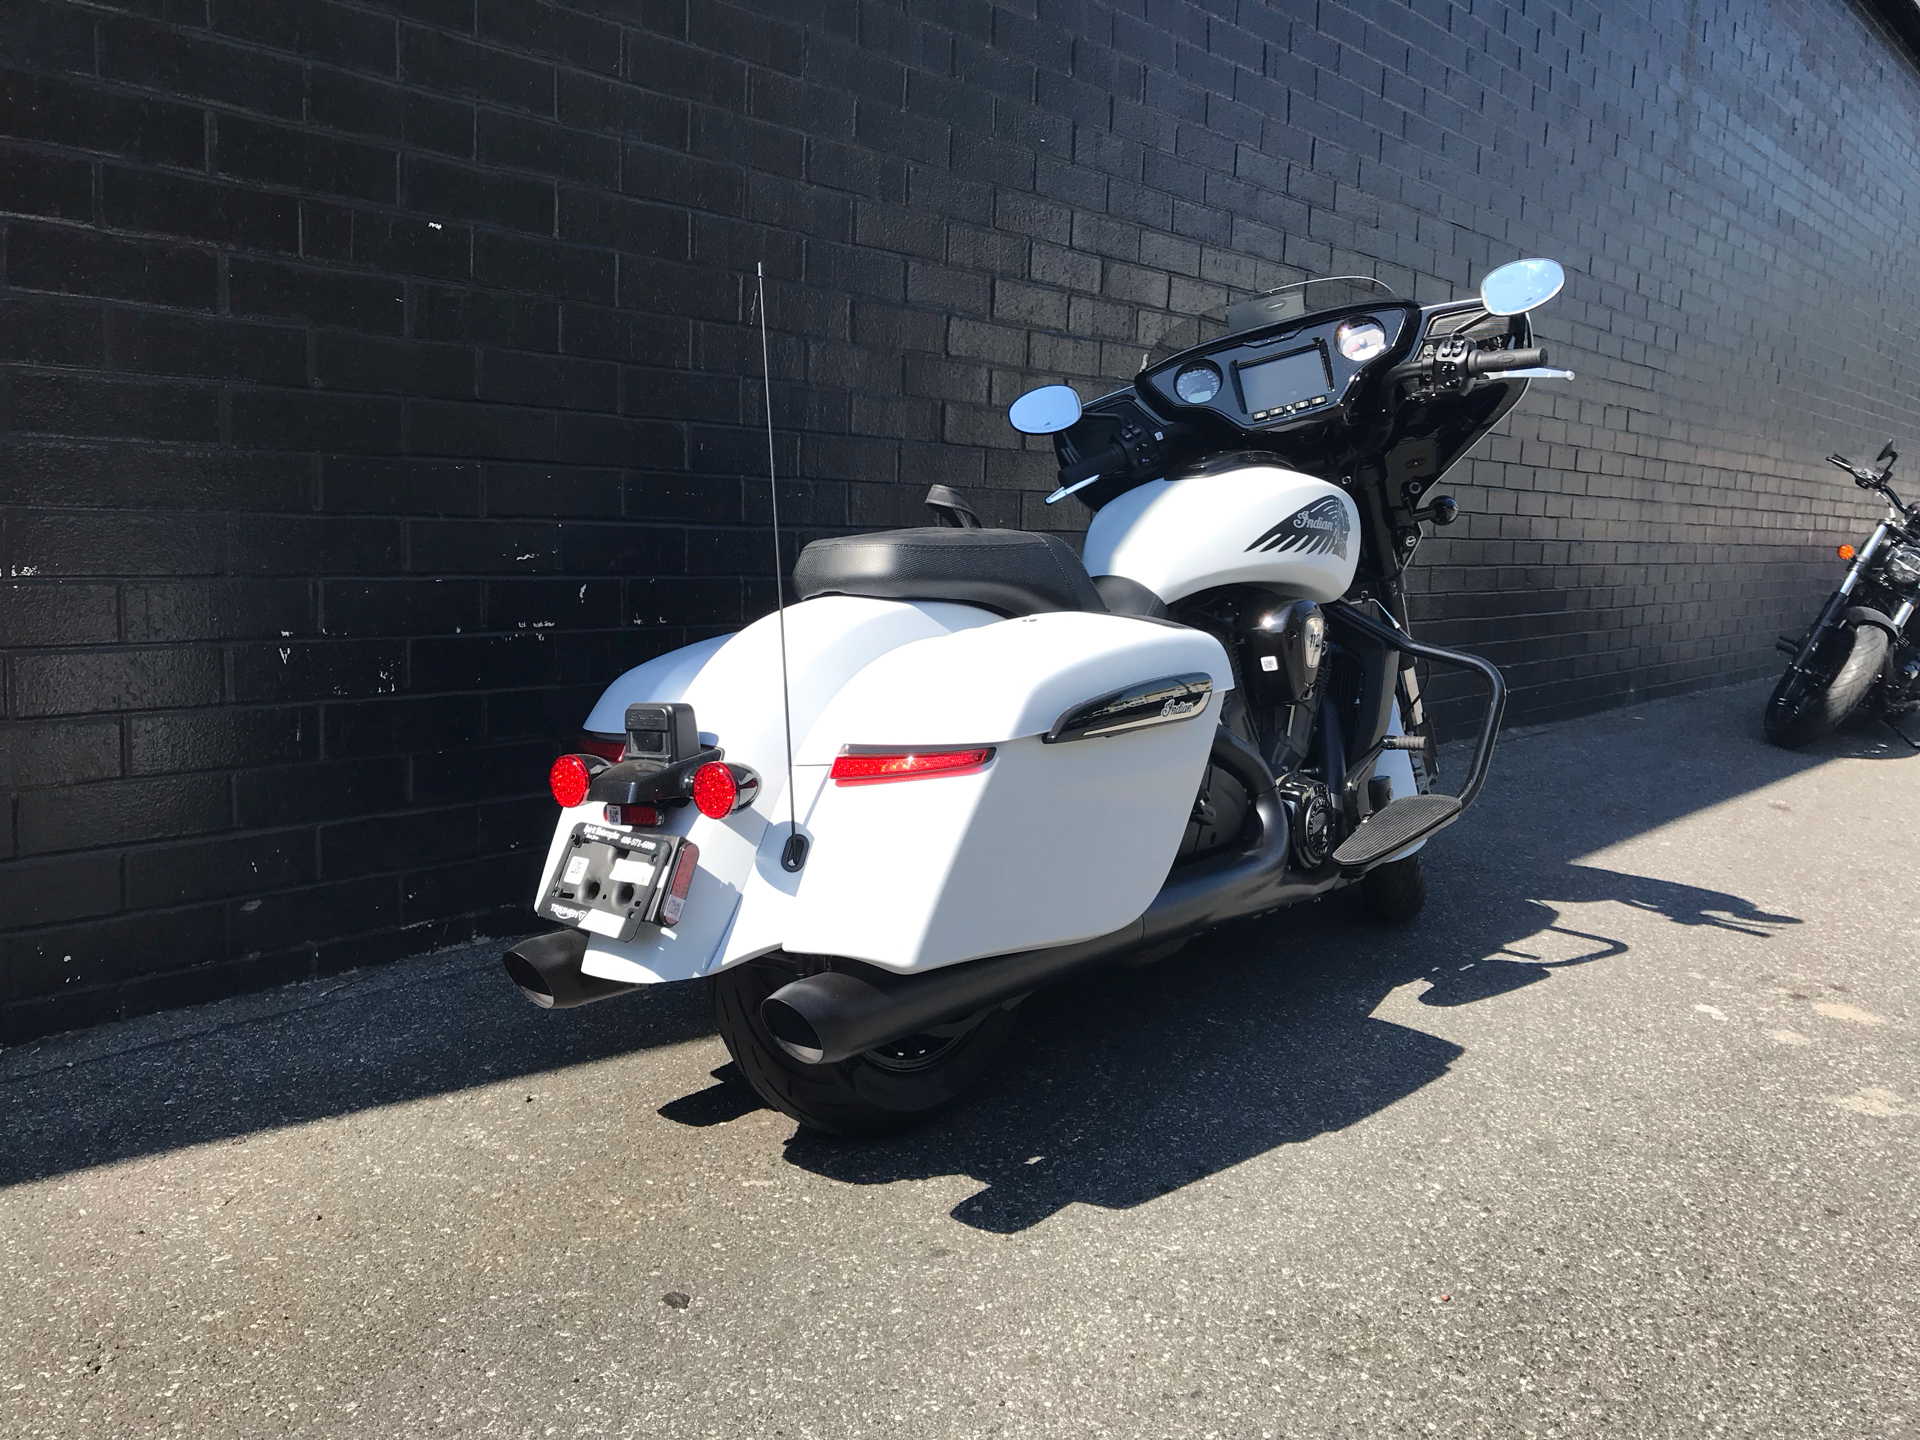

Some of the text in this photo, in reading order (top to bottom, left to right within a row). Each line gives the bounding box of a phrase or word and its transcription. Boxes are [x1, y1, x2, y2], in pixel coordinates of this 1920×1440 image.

[1292, 510, 1334, 532] Indian
[1161, 699, 1193, 717] Indian
[628, 710, 664, 726] Indian
[550, 903, 579, 919] TRIUMPH
